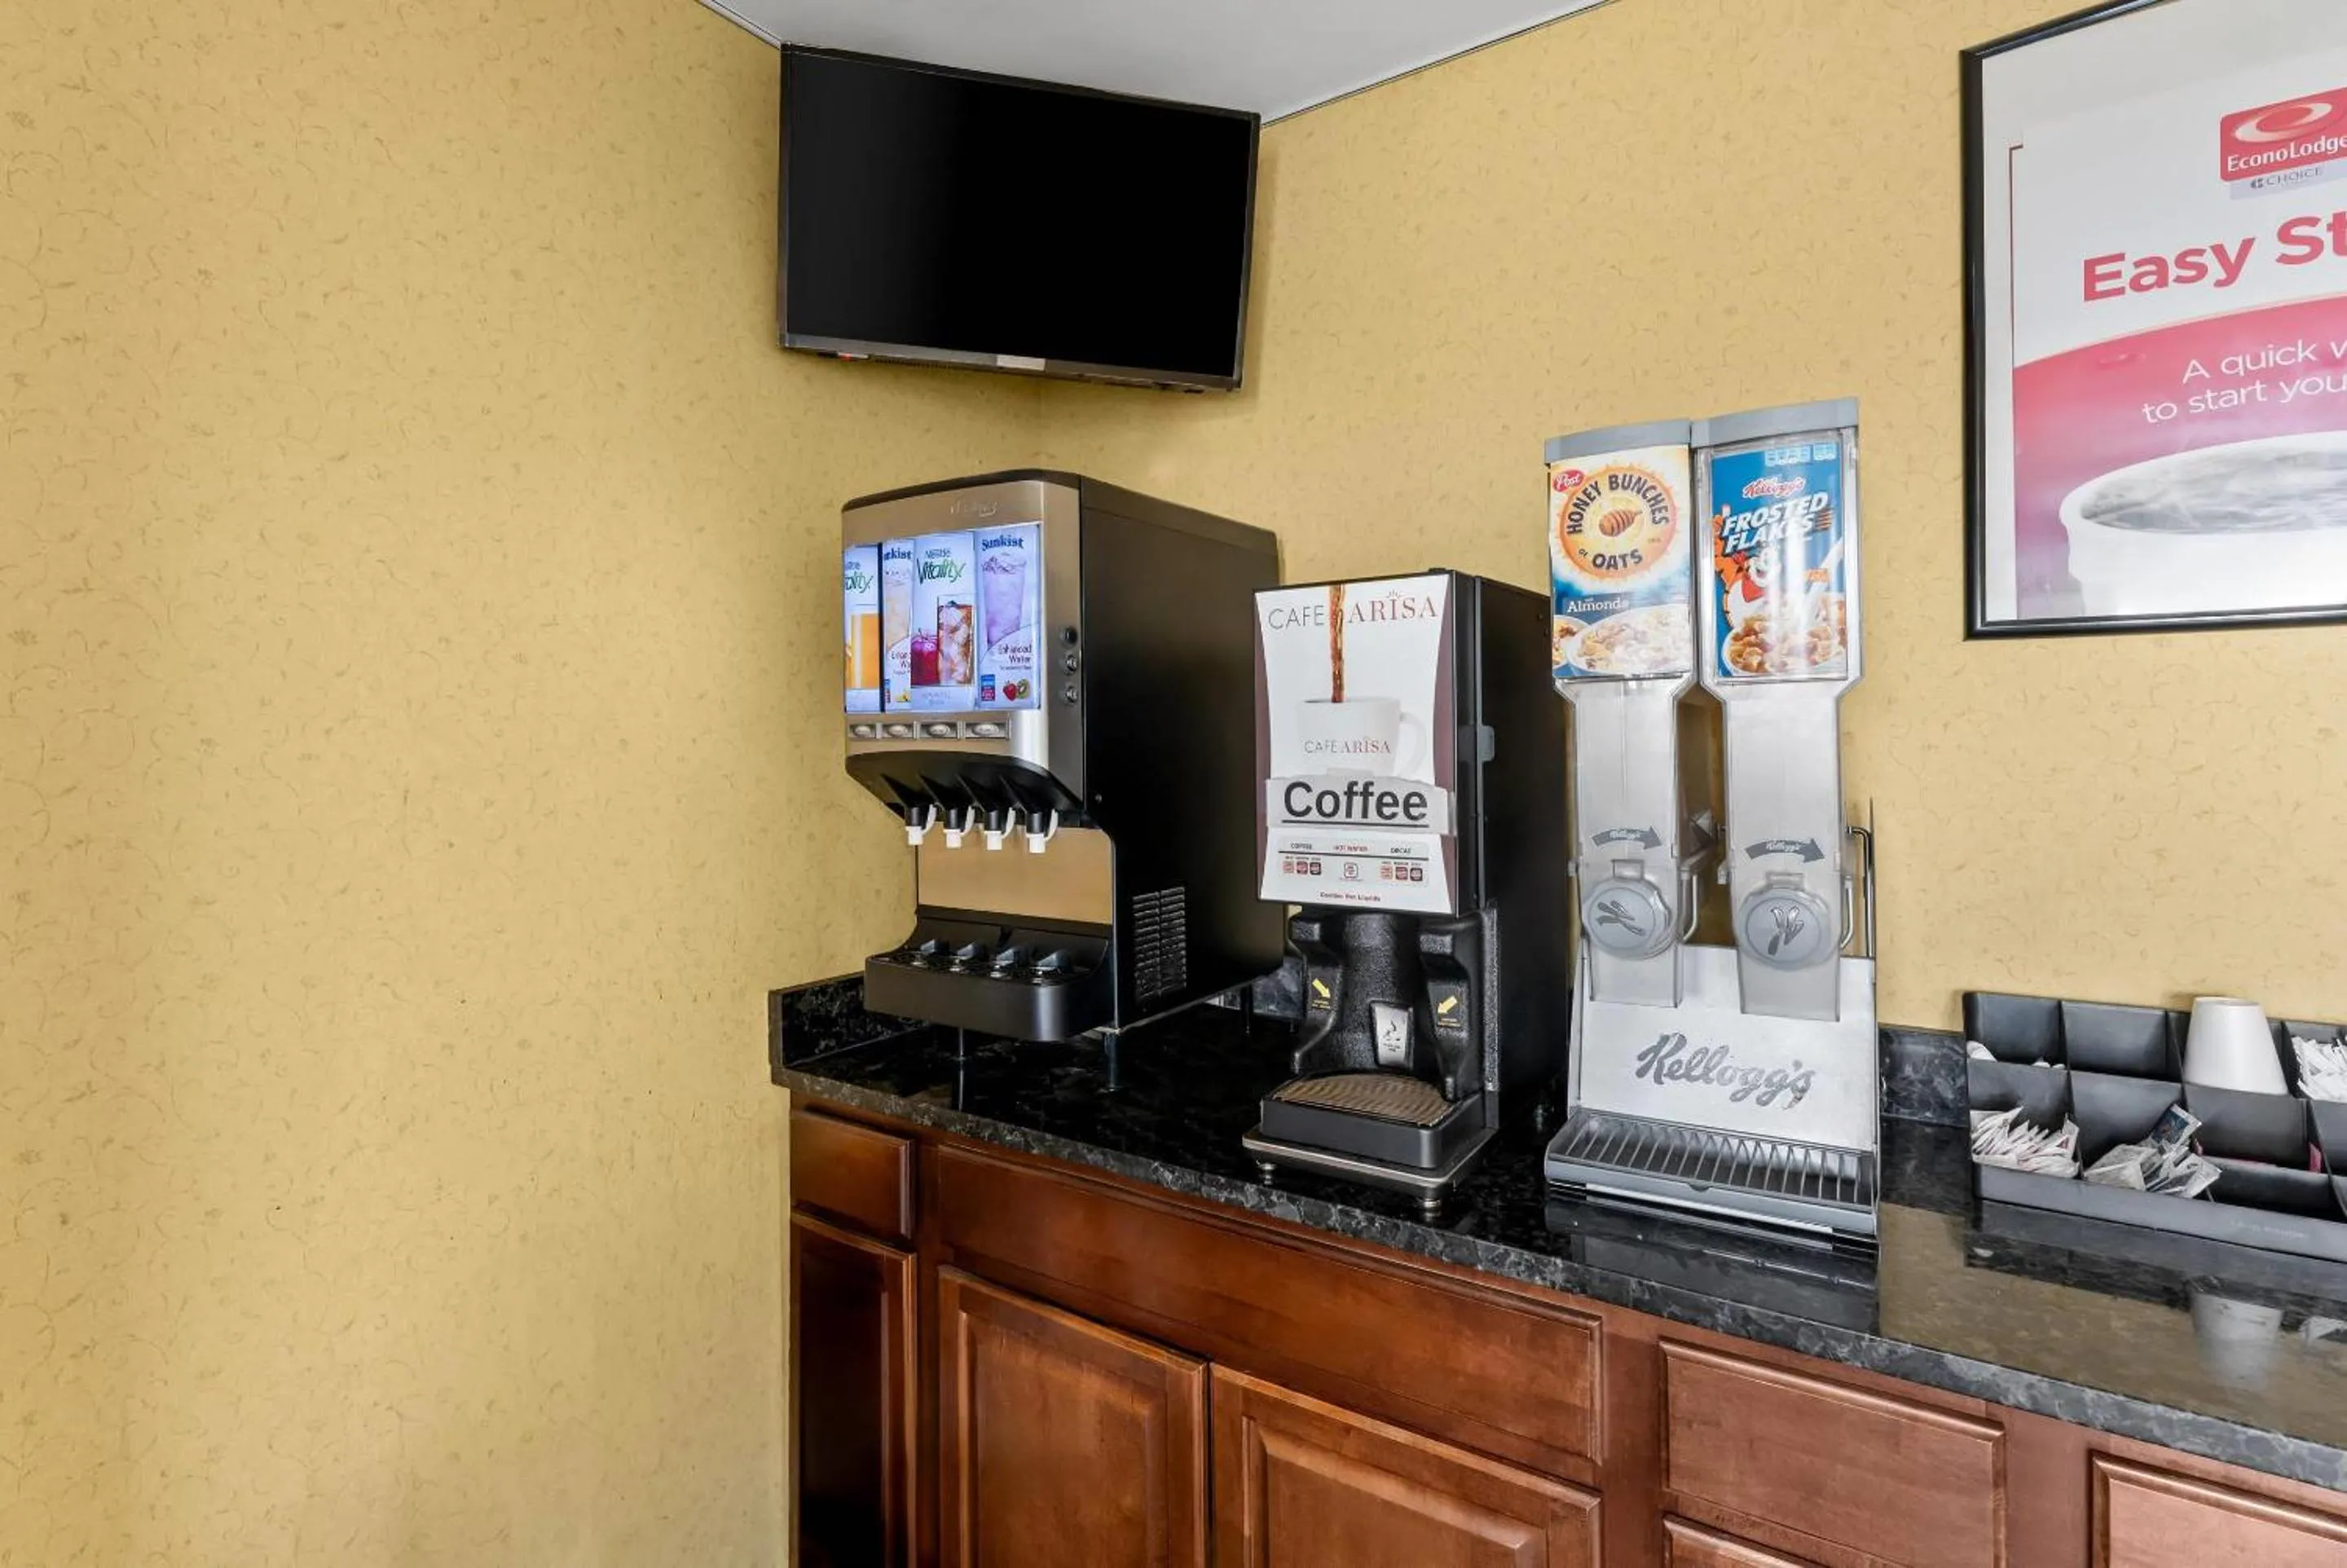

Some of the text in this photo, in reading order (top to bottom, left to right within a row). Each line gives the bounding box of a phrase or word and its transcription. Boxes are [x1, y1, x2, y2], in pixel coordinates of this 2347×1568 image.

[2227, 135, 2347, 171] EconoLodge
[2083, 237, 2256, 301] Easy
[2182, 359, 2211, 385] A
[2221, 339, 2318, 377] quick
[2142, 403, 2177, 423] to
[2188, 380, 2267, 413] start
[1566, 473, 1670, 535] HONEY BUNCHES
[1721, 491, 1829, 537] FROSTED
[1724, 513, 1816, 554] FLAKES
[916, 557, 967, 584] Vitality
[1592, 549, 1642, 570] OATS
[1268, 596, 1438, 630] CAFE ARISA
[1567, 597, 1629, 613] Almonds
[1304, 738, 1391, 754] CAFE ARISA
[1284, 781, 1428, 821] Coffee
[1635, 1032, 1816, 1110] Kellogg's
